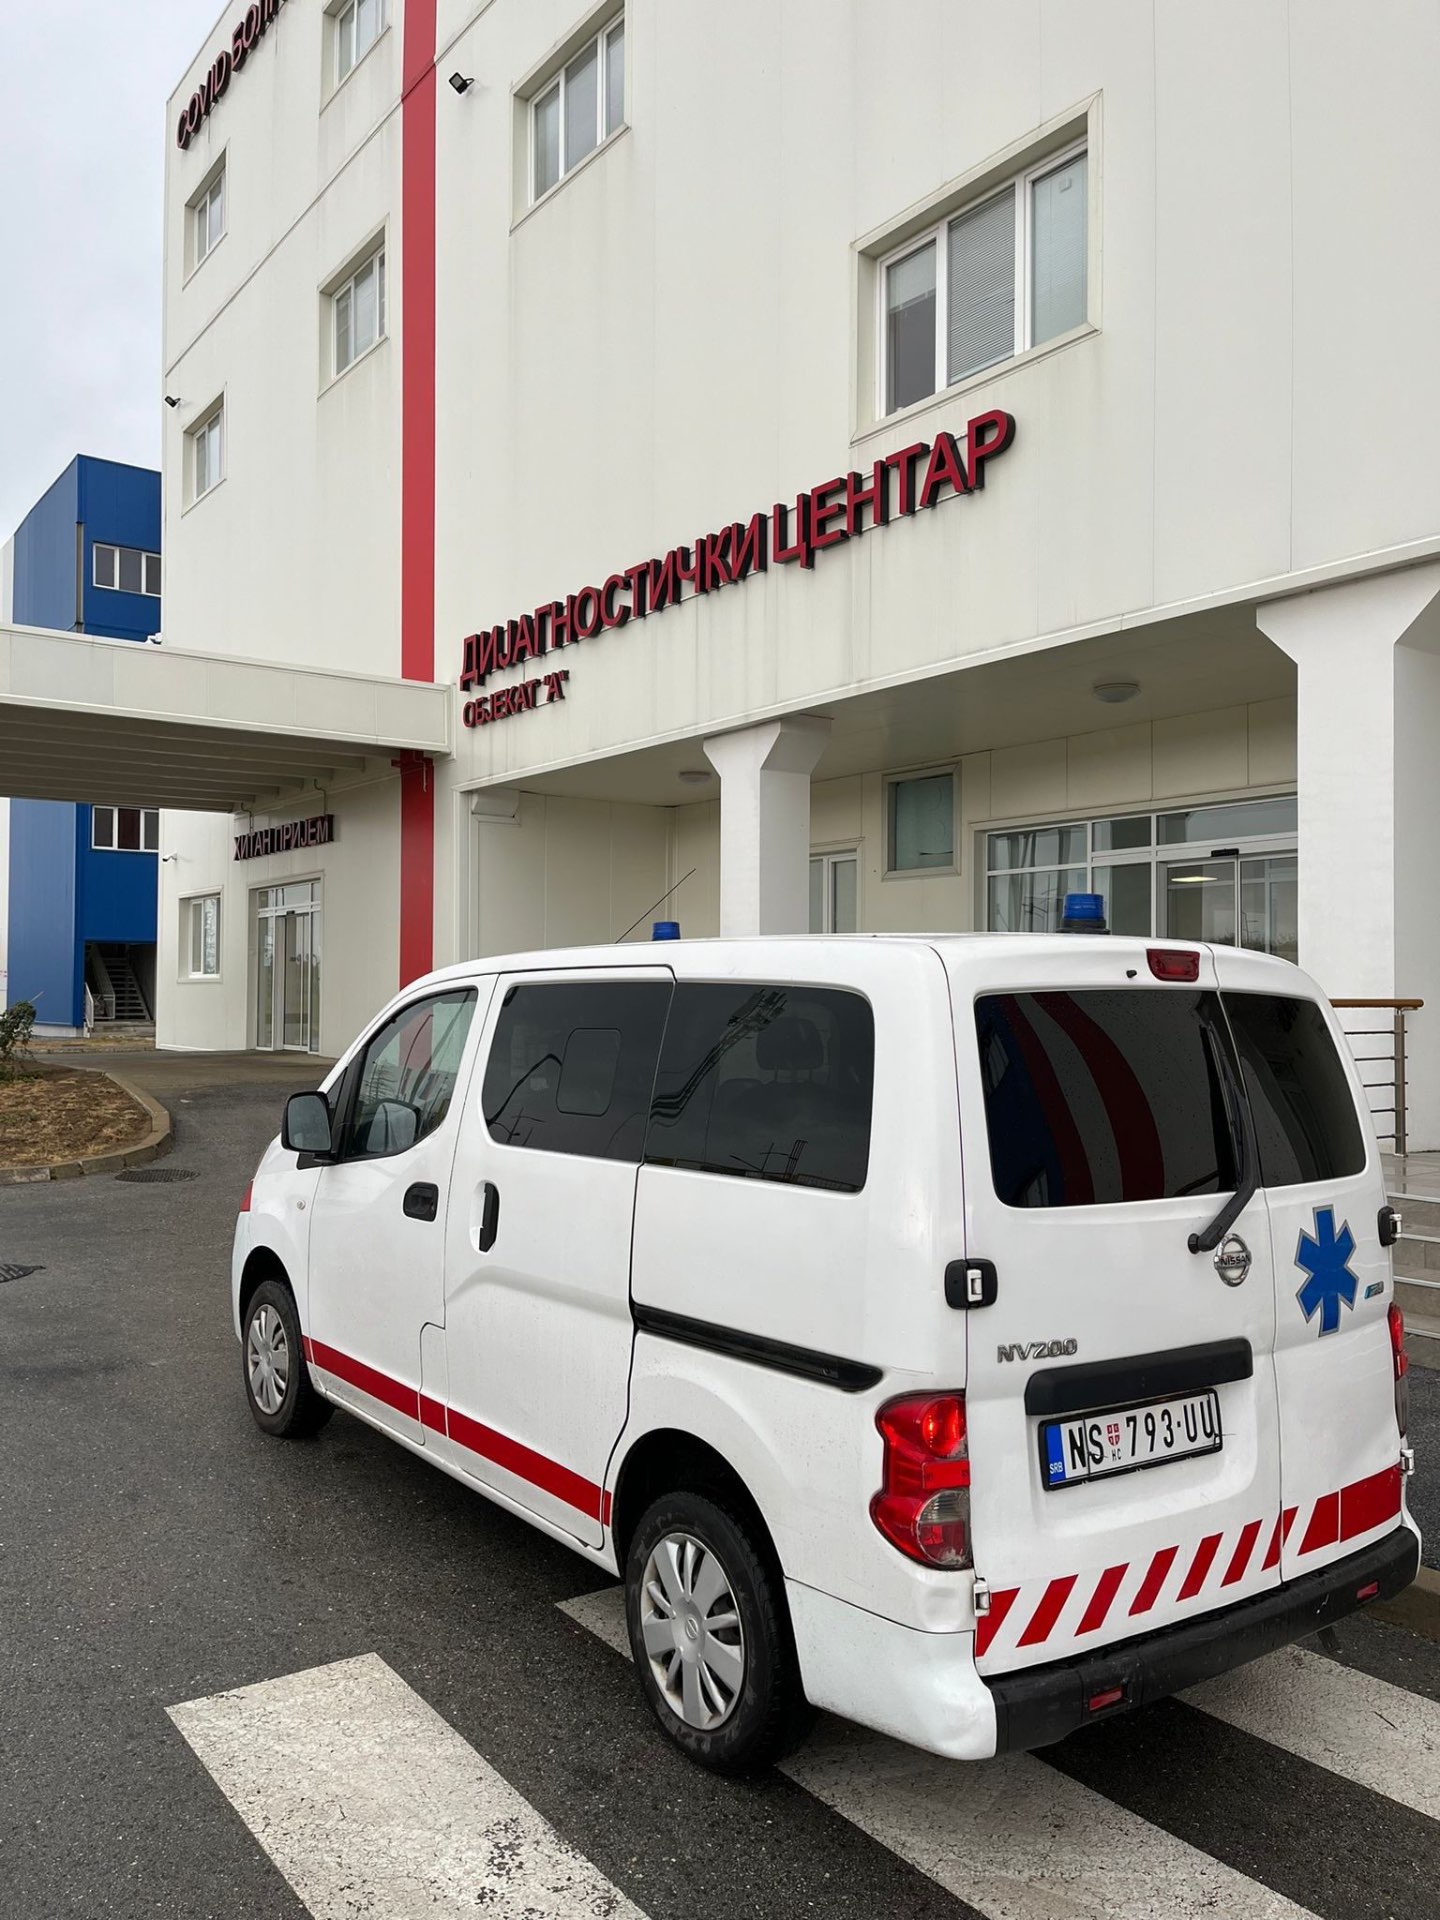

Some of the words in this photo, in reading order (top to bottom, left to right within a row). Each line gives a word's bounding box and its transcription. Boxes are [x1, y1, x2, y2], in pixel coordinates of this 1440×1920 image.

[177, 50, 232, 150] COVID
[460, 513, 767, 691] ДИЈАГНОСТИЧКИ
[773, 409, 1016, 569] ЦЕНТАР
[463, 679, 541, 728] ОБЈЕКАТ
[233, 828, 274, 861] ХИТАН
[275, 814, 334, 852] ПРИЈЕМ
[1220, 1254, 1251, 1266] NISSAN
[997, 1338, 1078, 1364] NV200
[1049, 1462, 1064, 1476] SRB
[1068, 1423, 1105, 1471] NS
